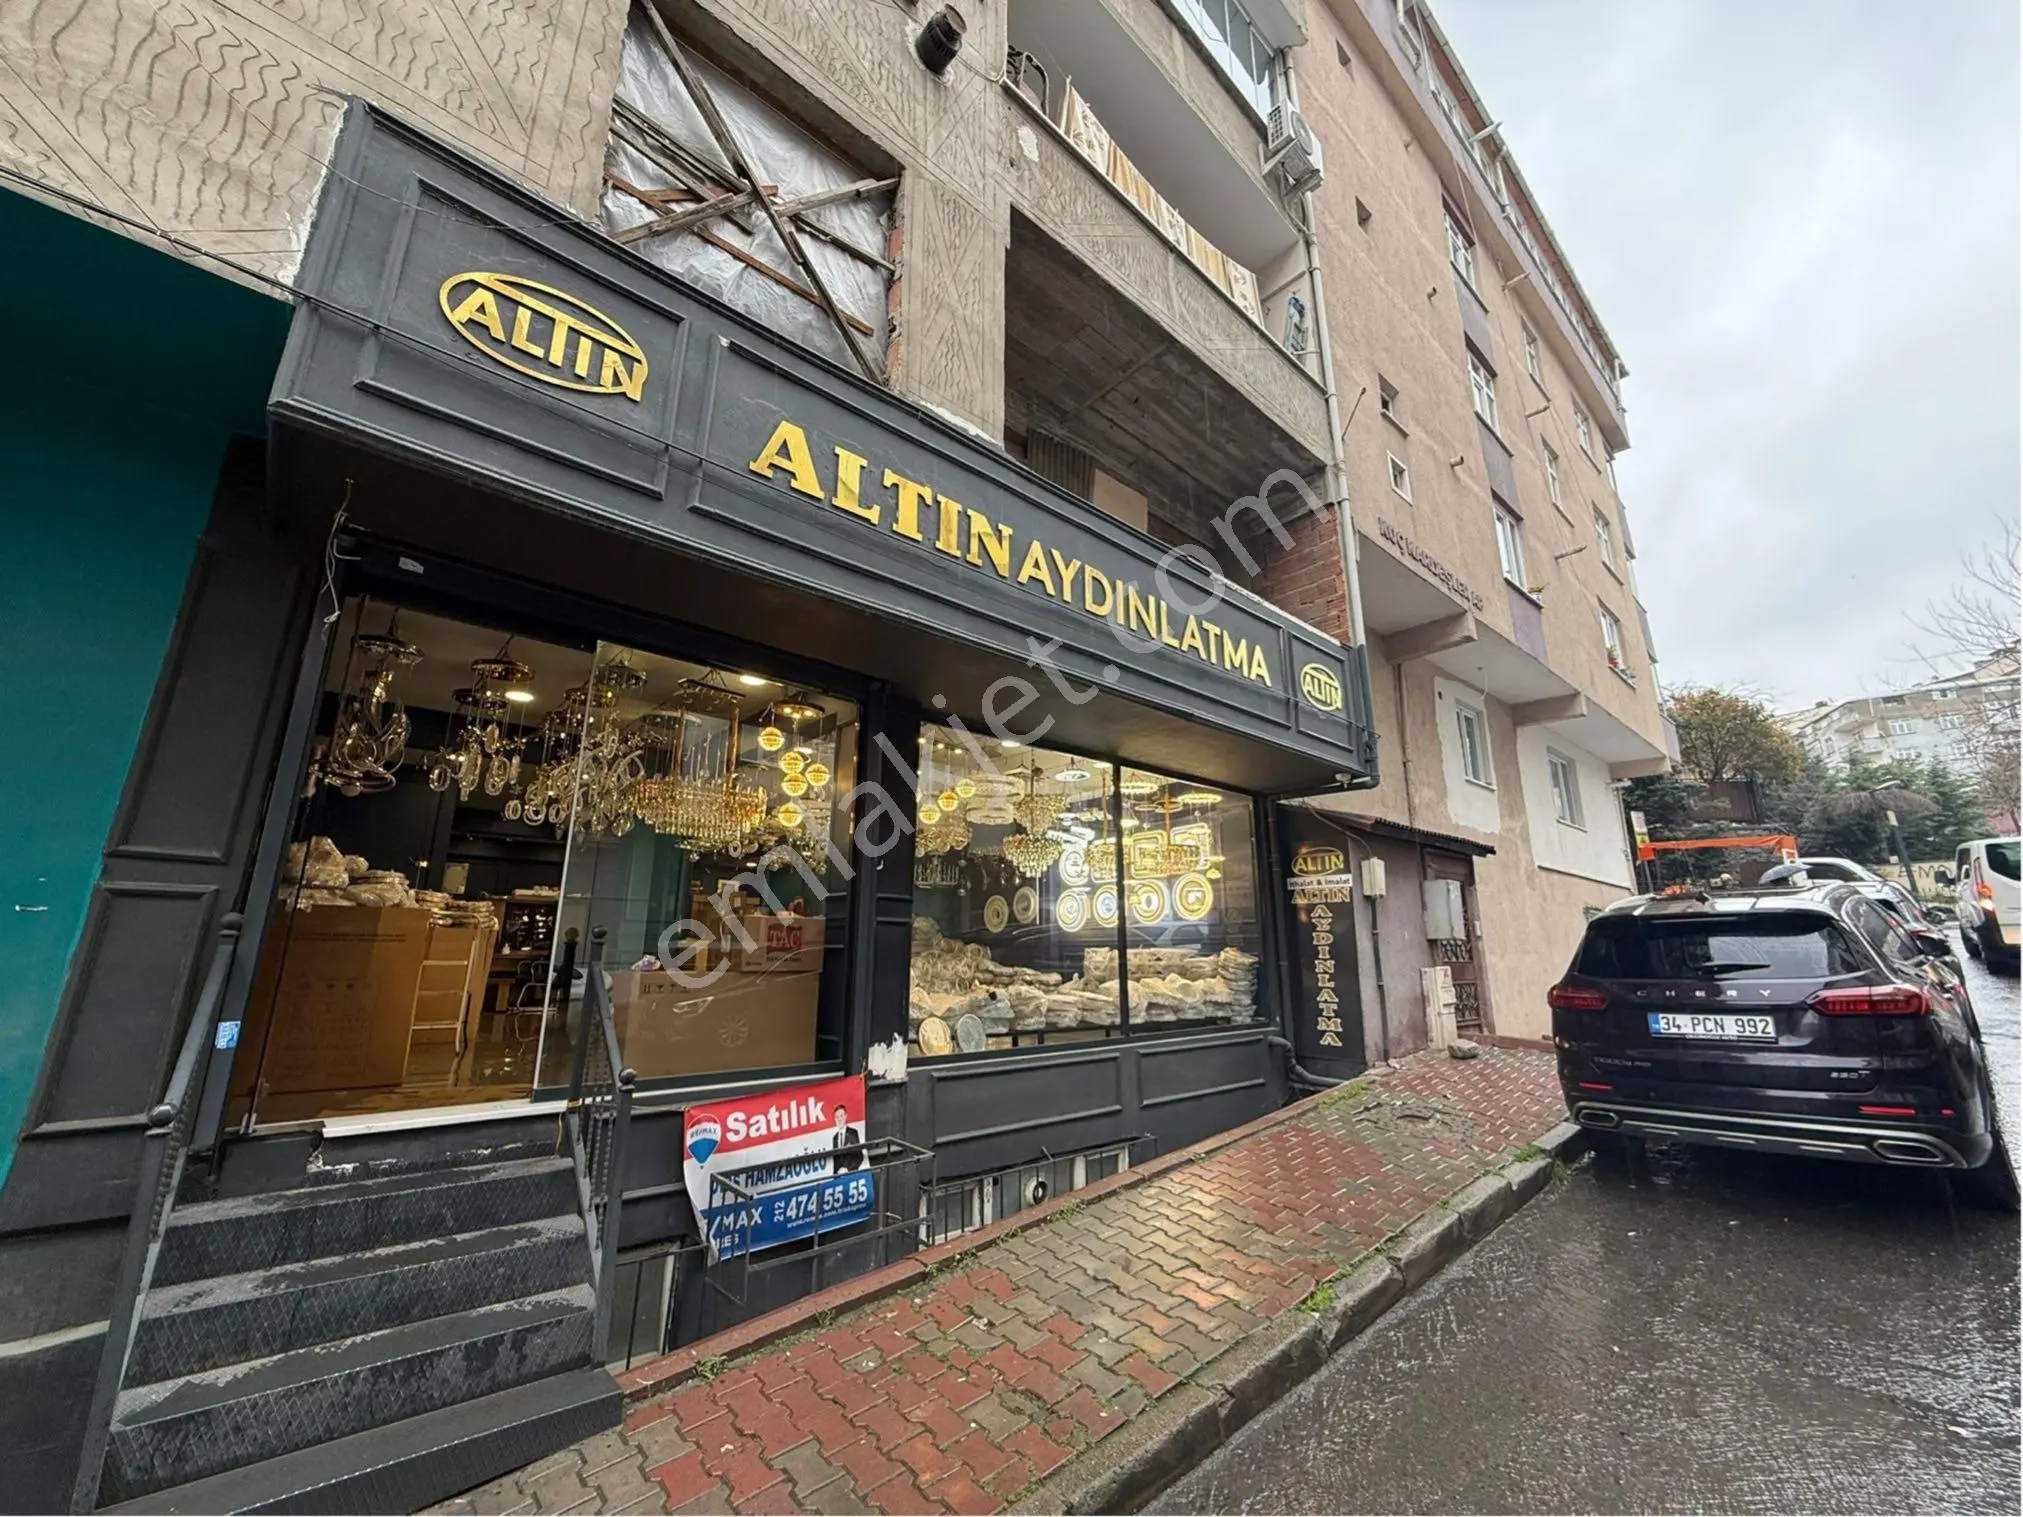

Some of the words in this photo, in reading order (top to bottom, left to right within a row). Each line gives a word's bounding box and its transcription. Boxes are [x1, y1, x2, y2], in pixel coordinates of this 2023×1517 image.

[448, 276, 646, 402] ALTIN
[749, 420, 1013, 578] ALTIN
[1017, 539, 1272, 687] AYDINLATMA
[1302, 666, 1342, 709] ALTIN
[1294, 851, 1344, 873] ALTIN
[1291, 886, 1351, 904] ALTIN
[1311, 904, 1343, 1047] AYDINLATMA
[1637, 988, 1771, 998] CHERY
[1660, 1016, 1682, 1032] 34
[1690, 1016, 1726, 1033] PCN
[1734, 1017, 1772, 1035] 992
[725, 1096, 826, 1142] Satılık
[773, 1200, 786, 1223] 212
[786, 1190, 818, 1220] 474
[823, 1187, 844, 1211] 55
[848, 1178, 868, 1205] 55
